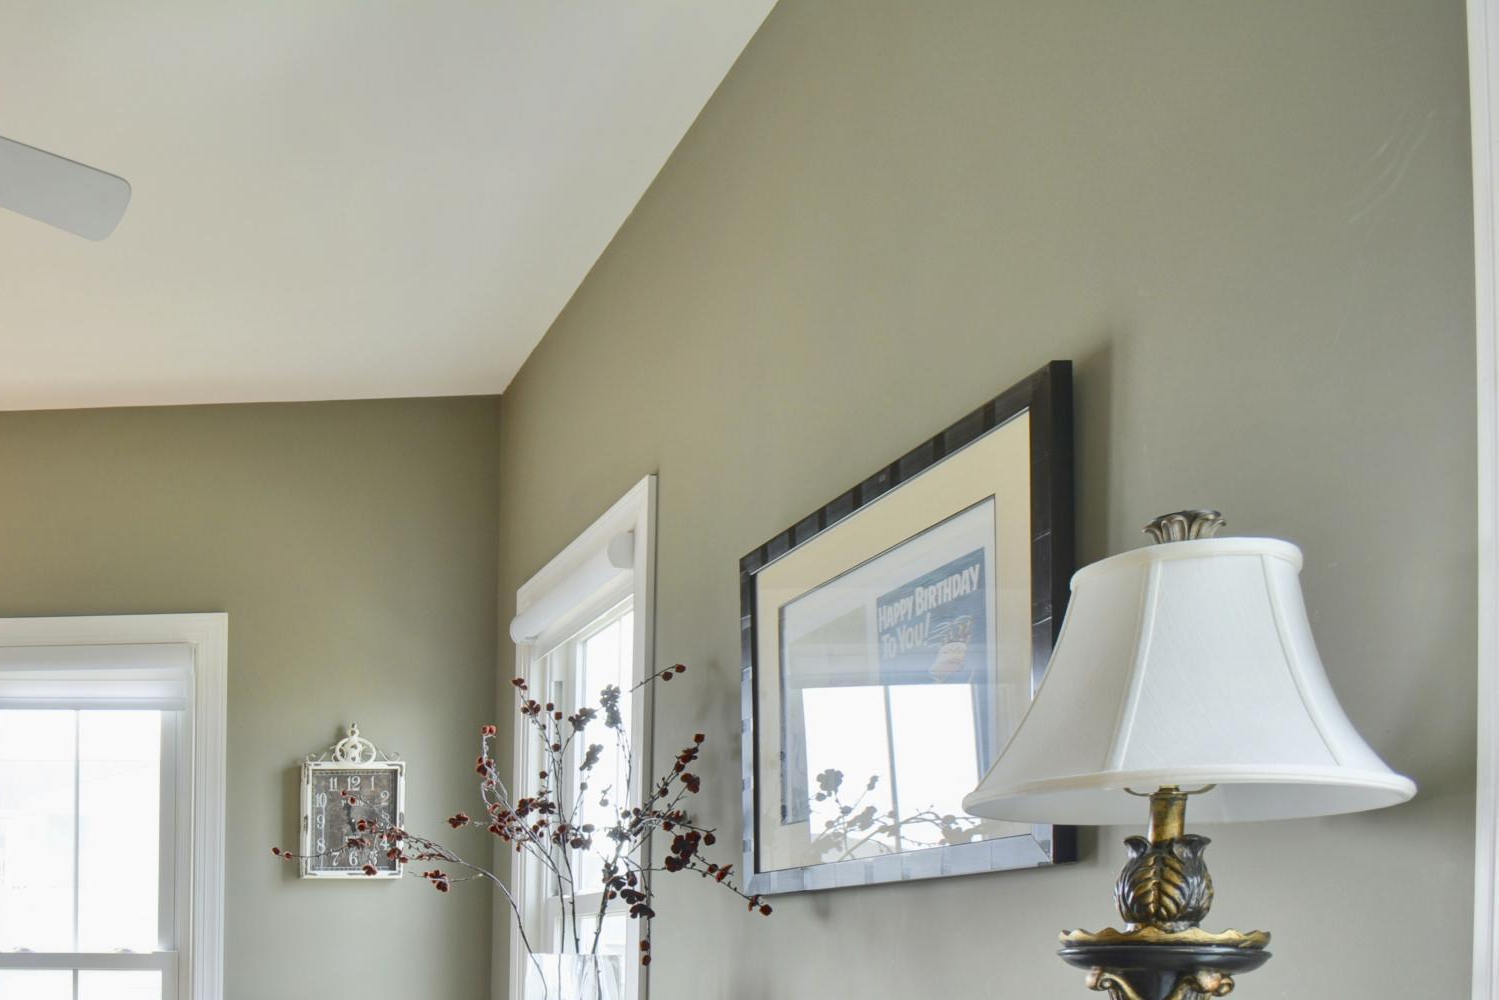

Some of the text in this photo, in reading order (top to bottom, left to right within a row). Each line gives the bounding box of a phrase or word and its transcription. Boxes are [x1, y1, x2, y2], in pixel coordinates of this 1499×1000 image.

[879, 564, 980, 632] HAPPY BIRTHDAY
[329, 777, 338, 791] 11
[347, 776, 360, 791] 12
[370, 776, 375, 790] 1
[315, 792, 327, 807] 10
[380, 791, 390, 806] 2
[317, 815, 325, 829] 9
[317, 839, 325, 854] 8
[331, 851, 340, 866] 7
[349, 851, 358, 866] 6
